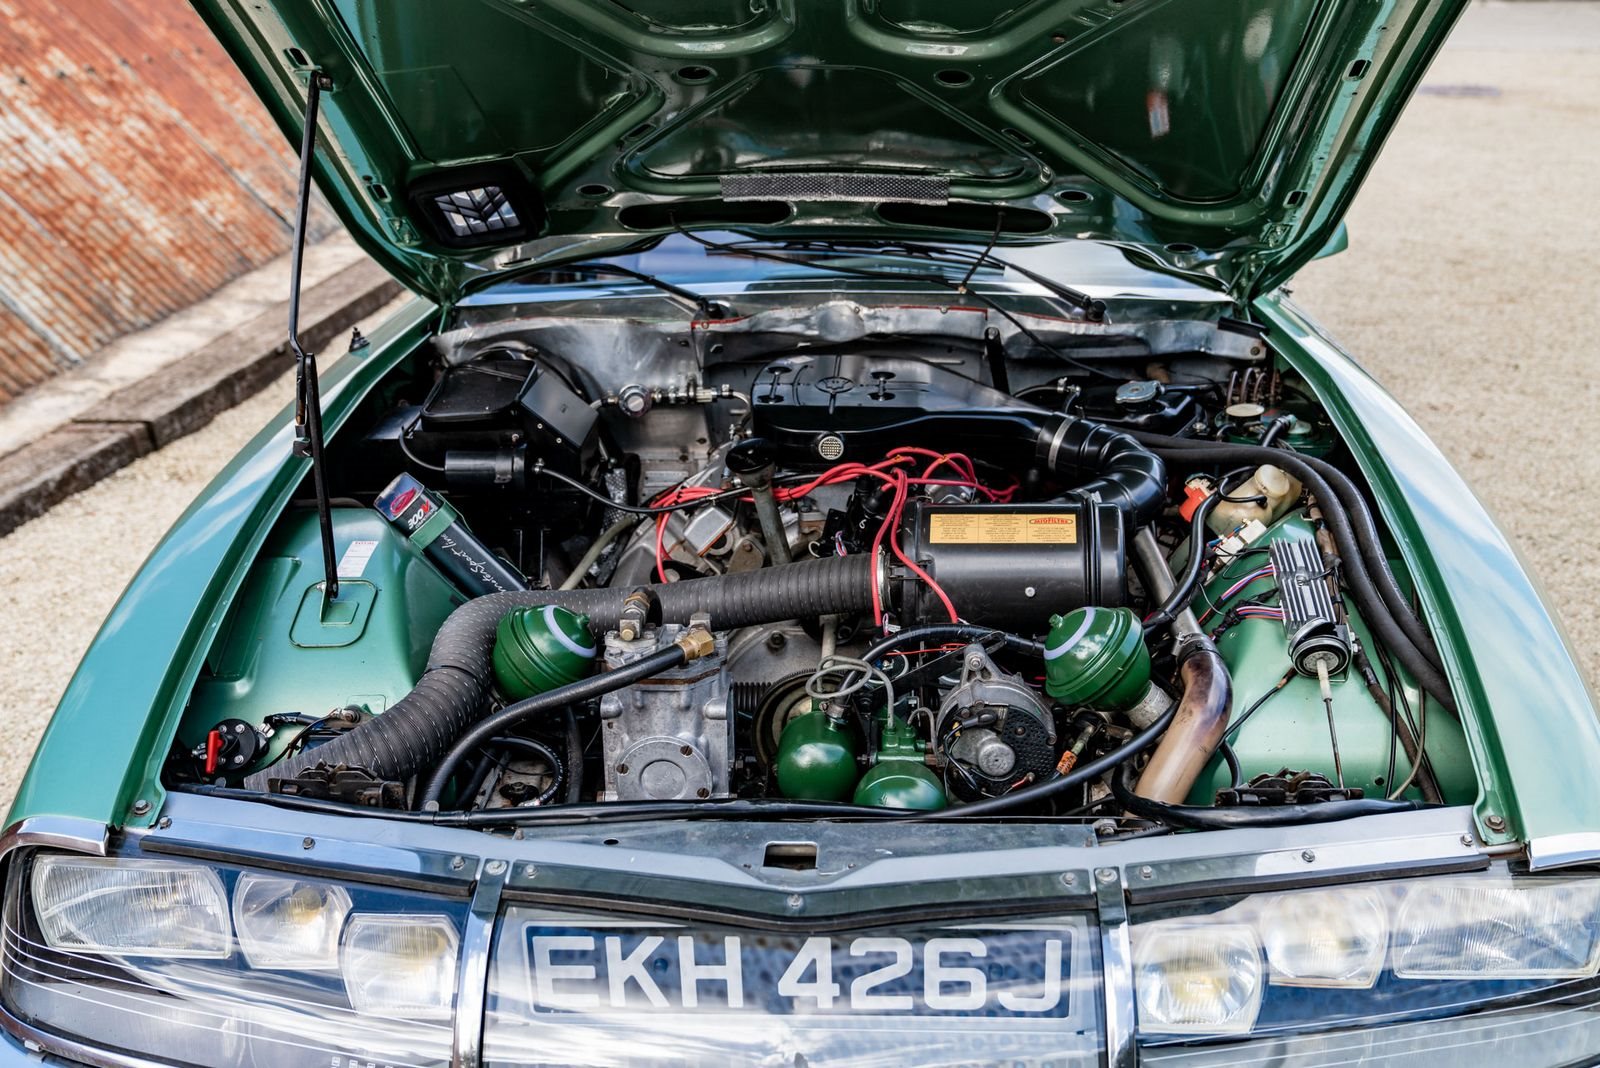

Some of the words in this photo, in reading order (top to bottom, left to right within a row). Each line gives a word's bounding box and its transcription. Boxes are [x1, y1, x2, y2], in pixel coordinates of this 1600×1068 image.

[408, 499, 431, 530] 300V
[532, 936, 743, 1009] EKH
[777, 937, 1062, 1012] 426J
